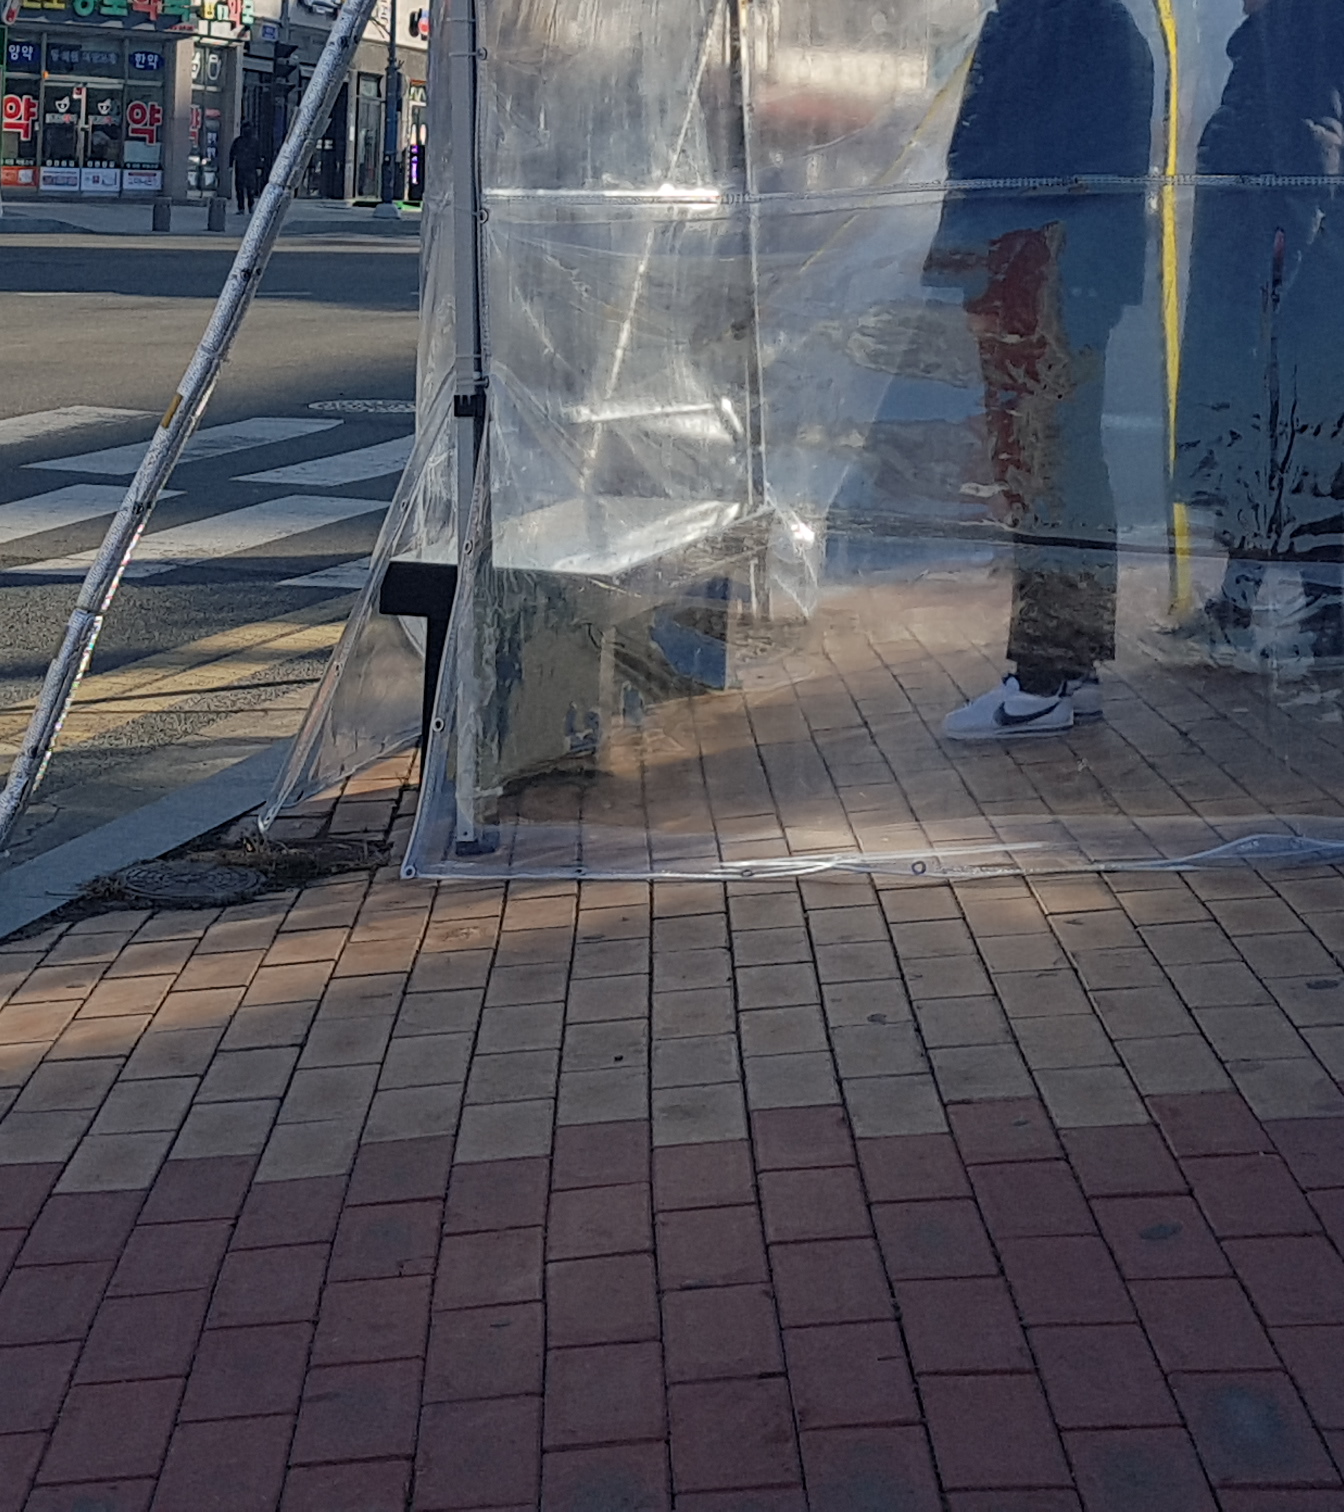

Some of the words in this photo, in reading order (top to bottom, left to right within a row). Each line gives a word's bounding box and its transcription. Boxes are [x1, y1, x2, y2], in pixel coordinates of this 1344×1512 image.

[134, 52, 159, 69] 한약
[3, 94, 39, 140] 약
[127, 101, 163, 145] 약
